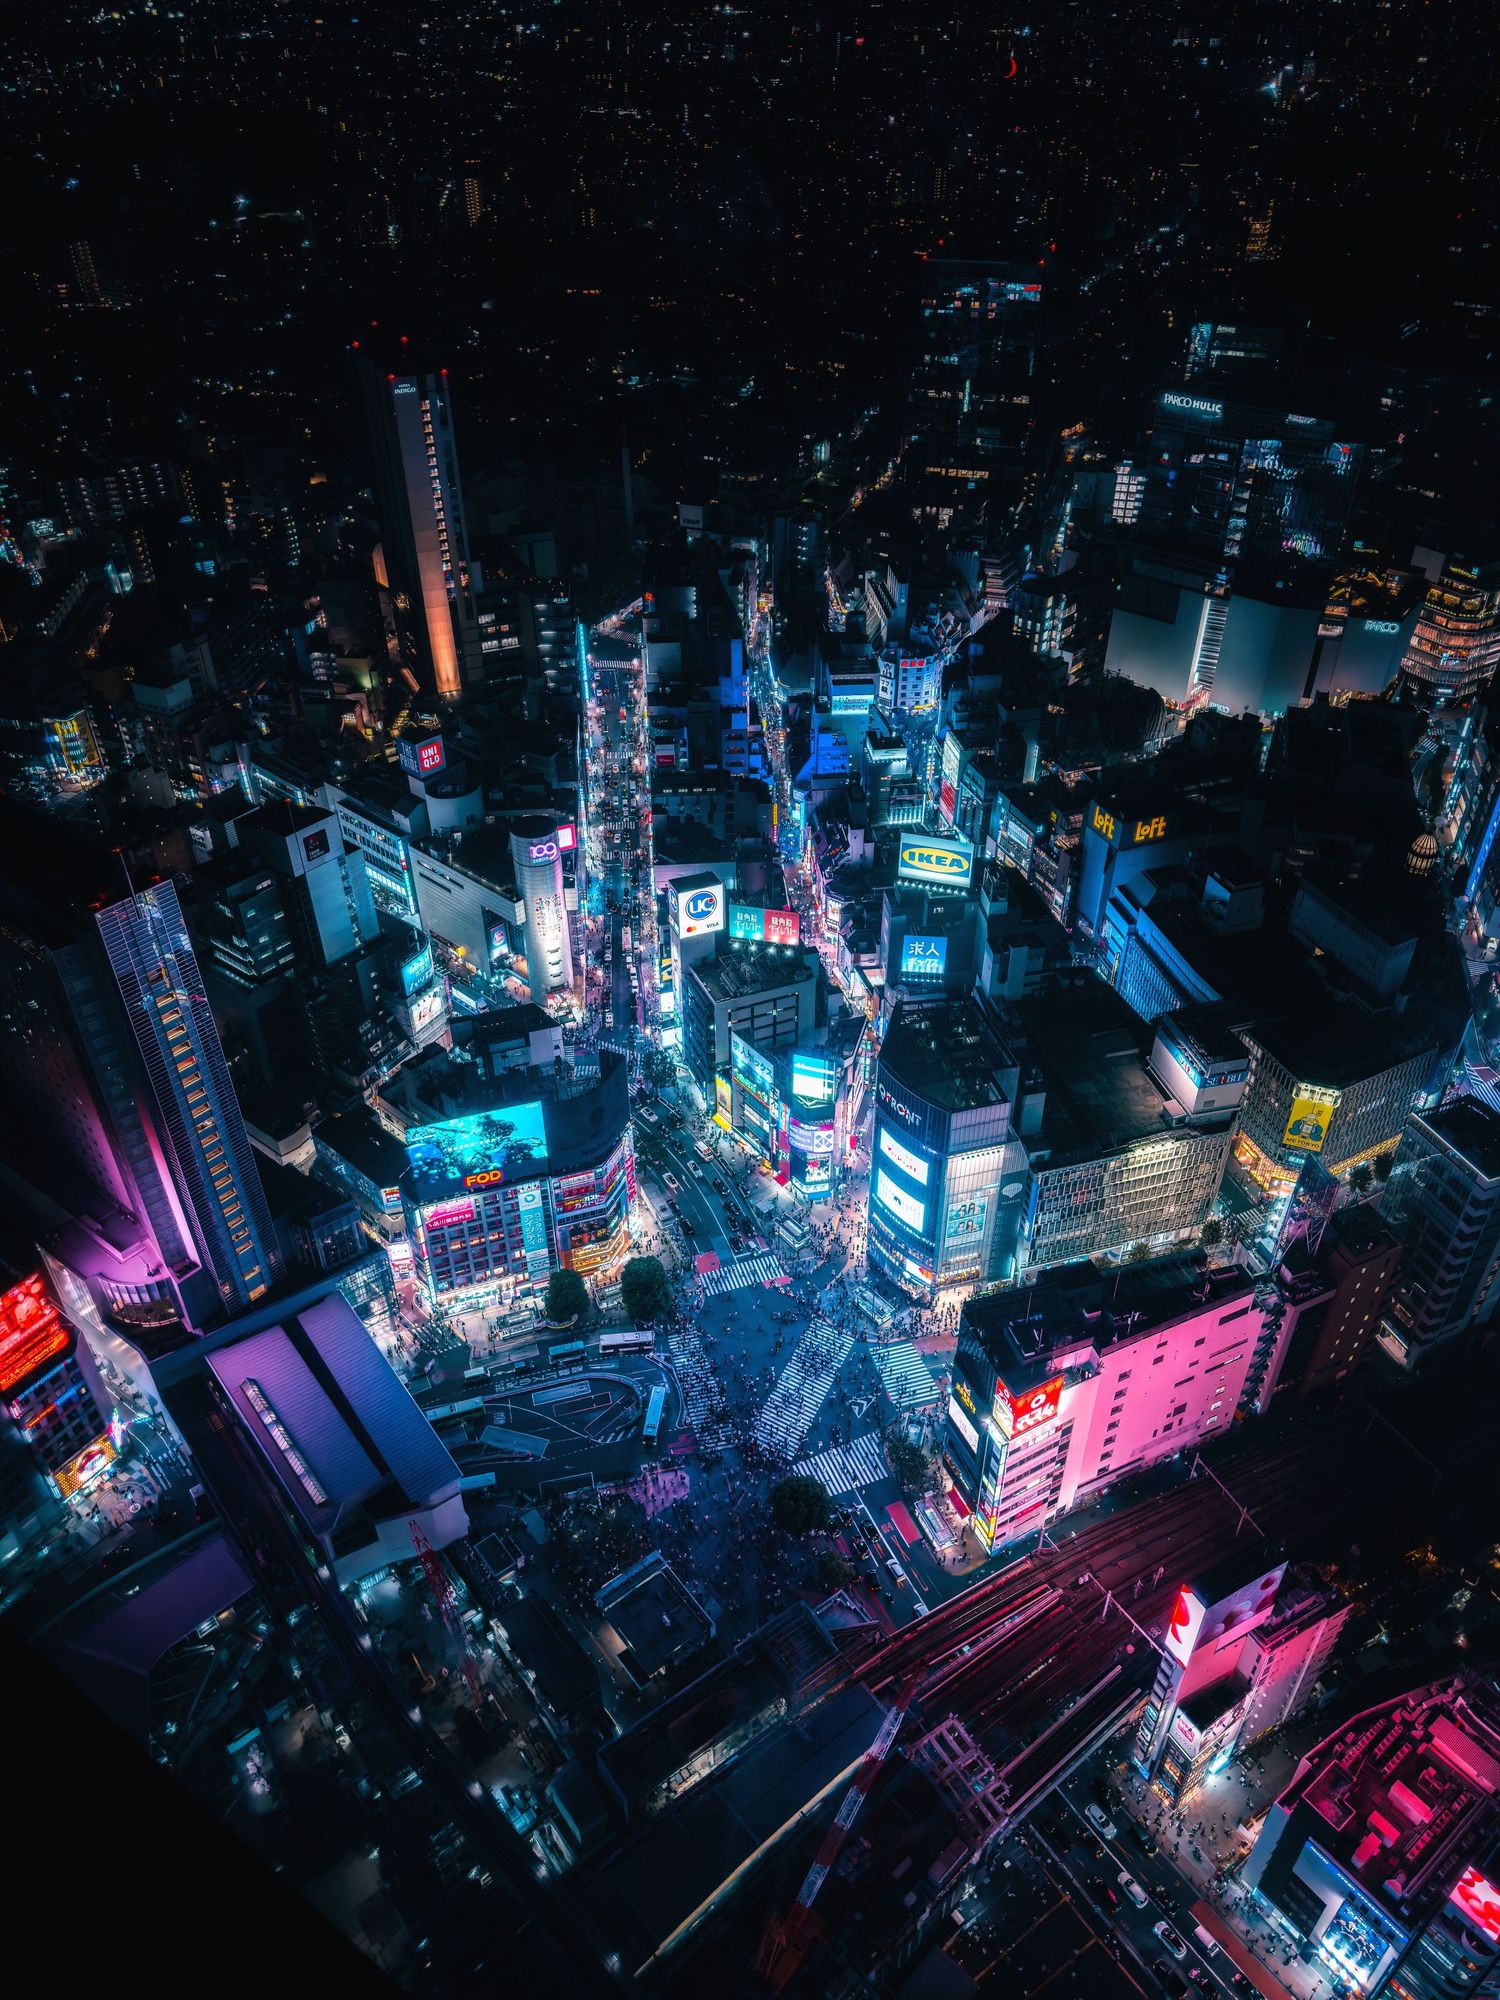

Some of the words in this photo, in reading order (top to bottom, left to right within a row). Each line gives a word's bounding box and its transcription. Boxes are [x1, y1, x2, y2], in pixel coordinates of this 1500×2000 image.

[1165, 393, 1192, 407] PARCO
[1193, 400, 1222, 412] HULIC
[1365, 620, 1400, 633] PARCO
[422, 746, 437, 758] UNI
[424, 755, 440, 768] QLO
[530, 842, 557, 859] 109
[908, 851, 964, 869] IKEA
[690, 898, 713, 913] UC
[908, 942, 939, 956] 求人
[466, 1170, 502, 1187] FOD
